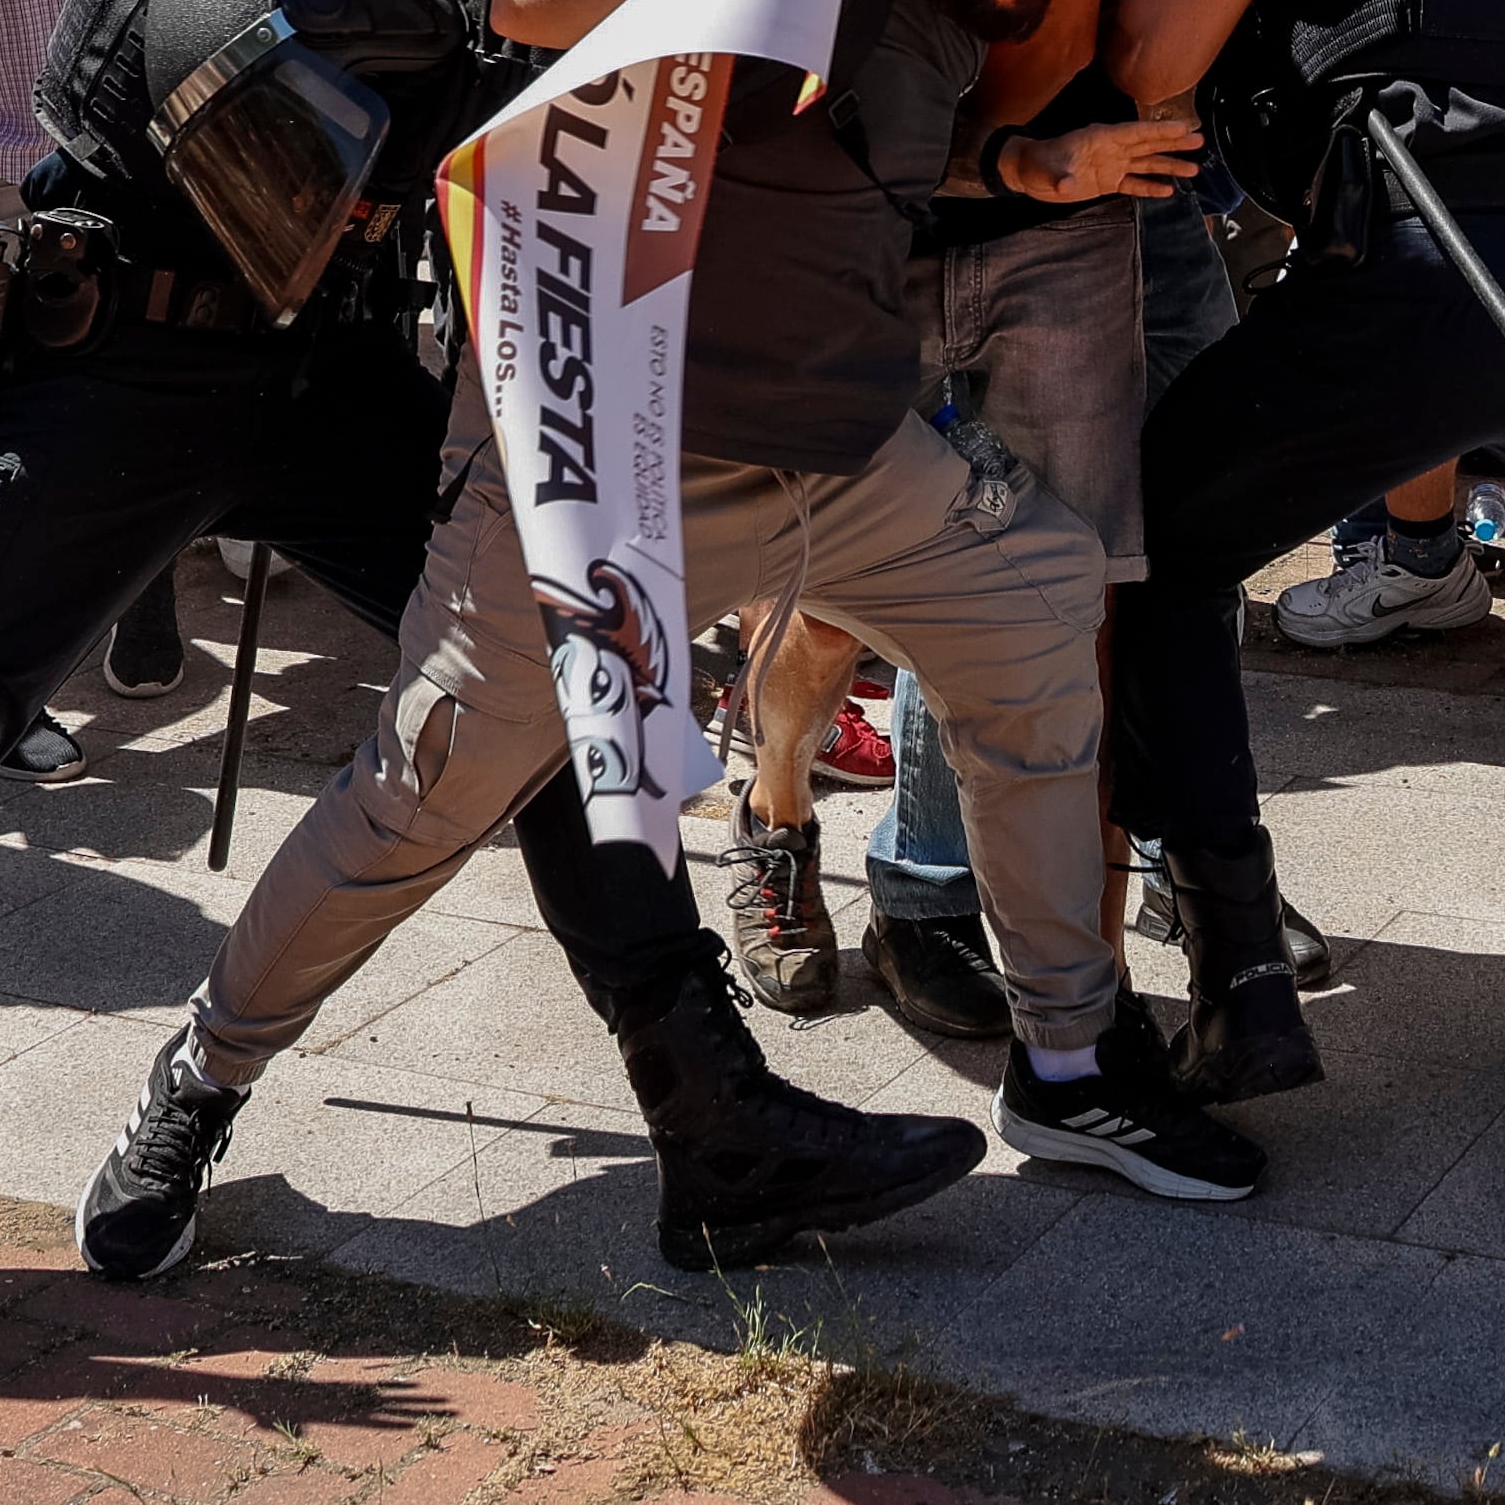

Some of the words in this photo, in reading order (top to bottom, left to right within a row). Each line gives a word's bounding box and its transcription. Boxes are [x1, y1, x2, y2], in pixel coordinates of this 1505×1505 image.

[537, 103, 610, 216] LA
[641, 53, 713, 232] ESPAÑA
[534, 220, 598, 507] FIESTA
[648, 380, 665, 418] NO
